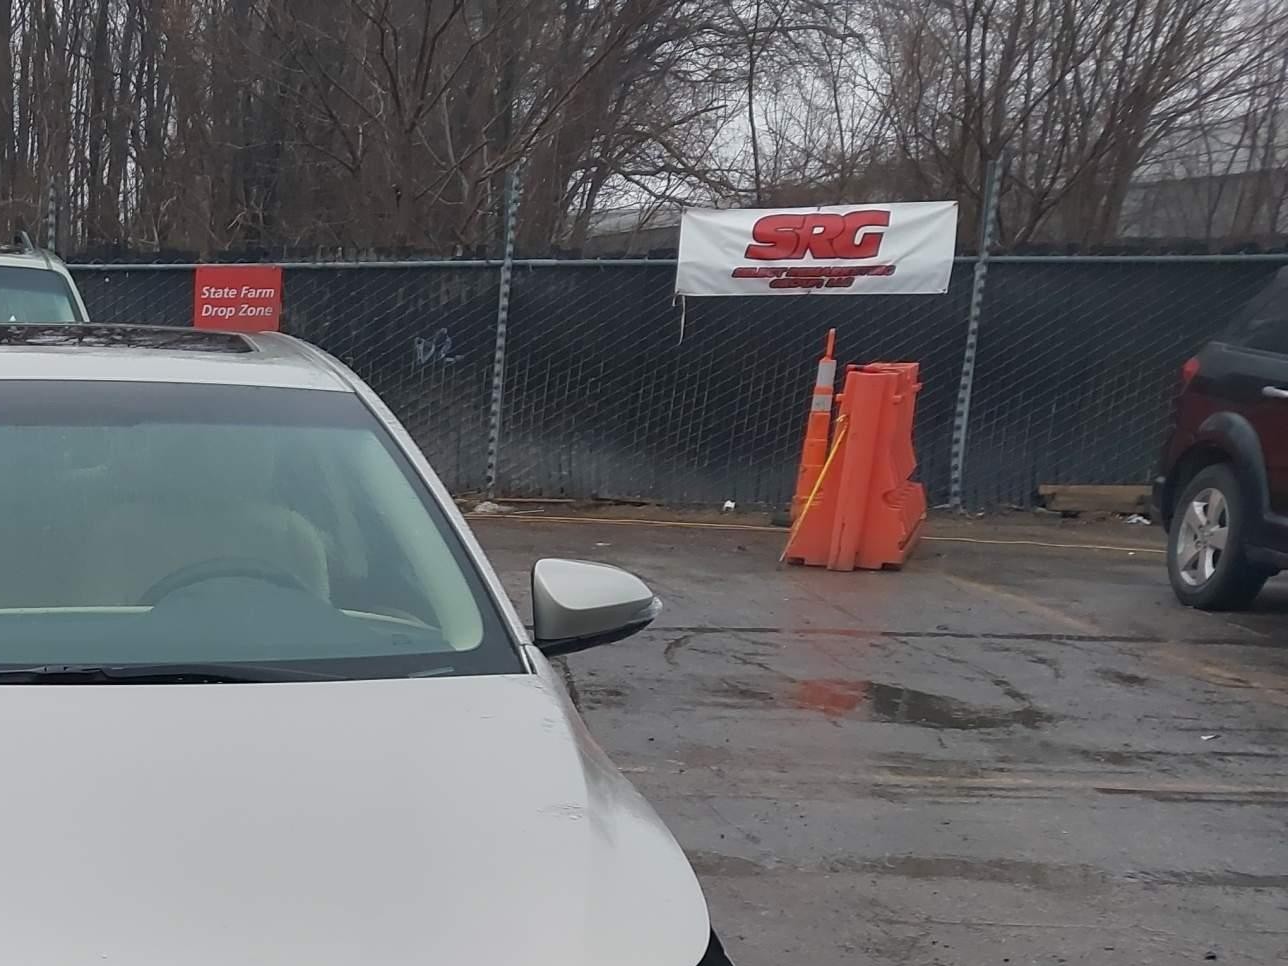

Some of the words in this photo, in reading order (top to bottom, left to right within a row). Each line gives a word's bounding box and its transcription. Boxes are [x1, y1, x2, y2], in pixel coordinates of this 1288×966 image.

[744, 209, 891, 260] SRG
[201, 286, 237, 298] State
[240, 286, 274, 298] Farm
[201, 305, 235, 319] Drop
[239, 305, 273, 317] Zone
